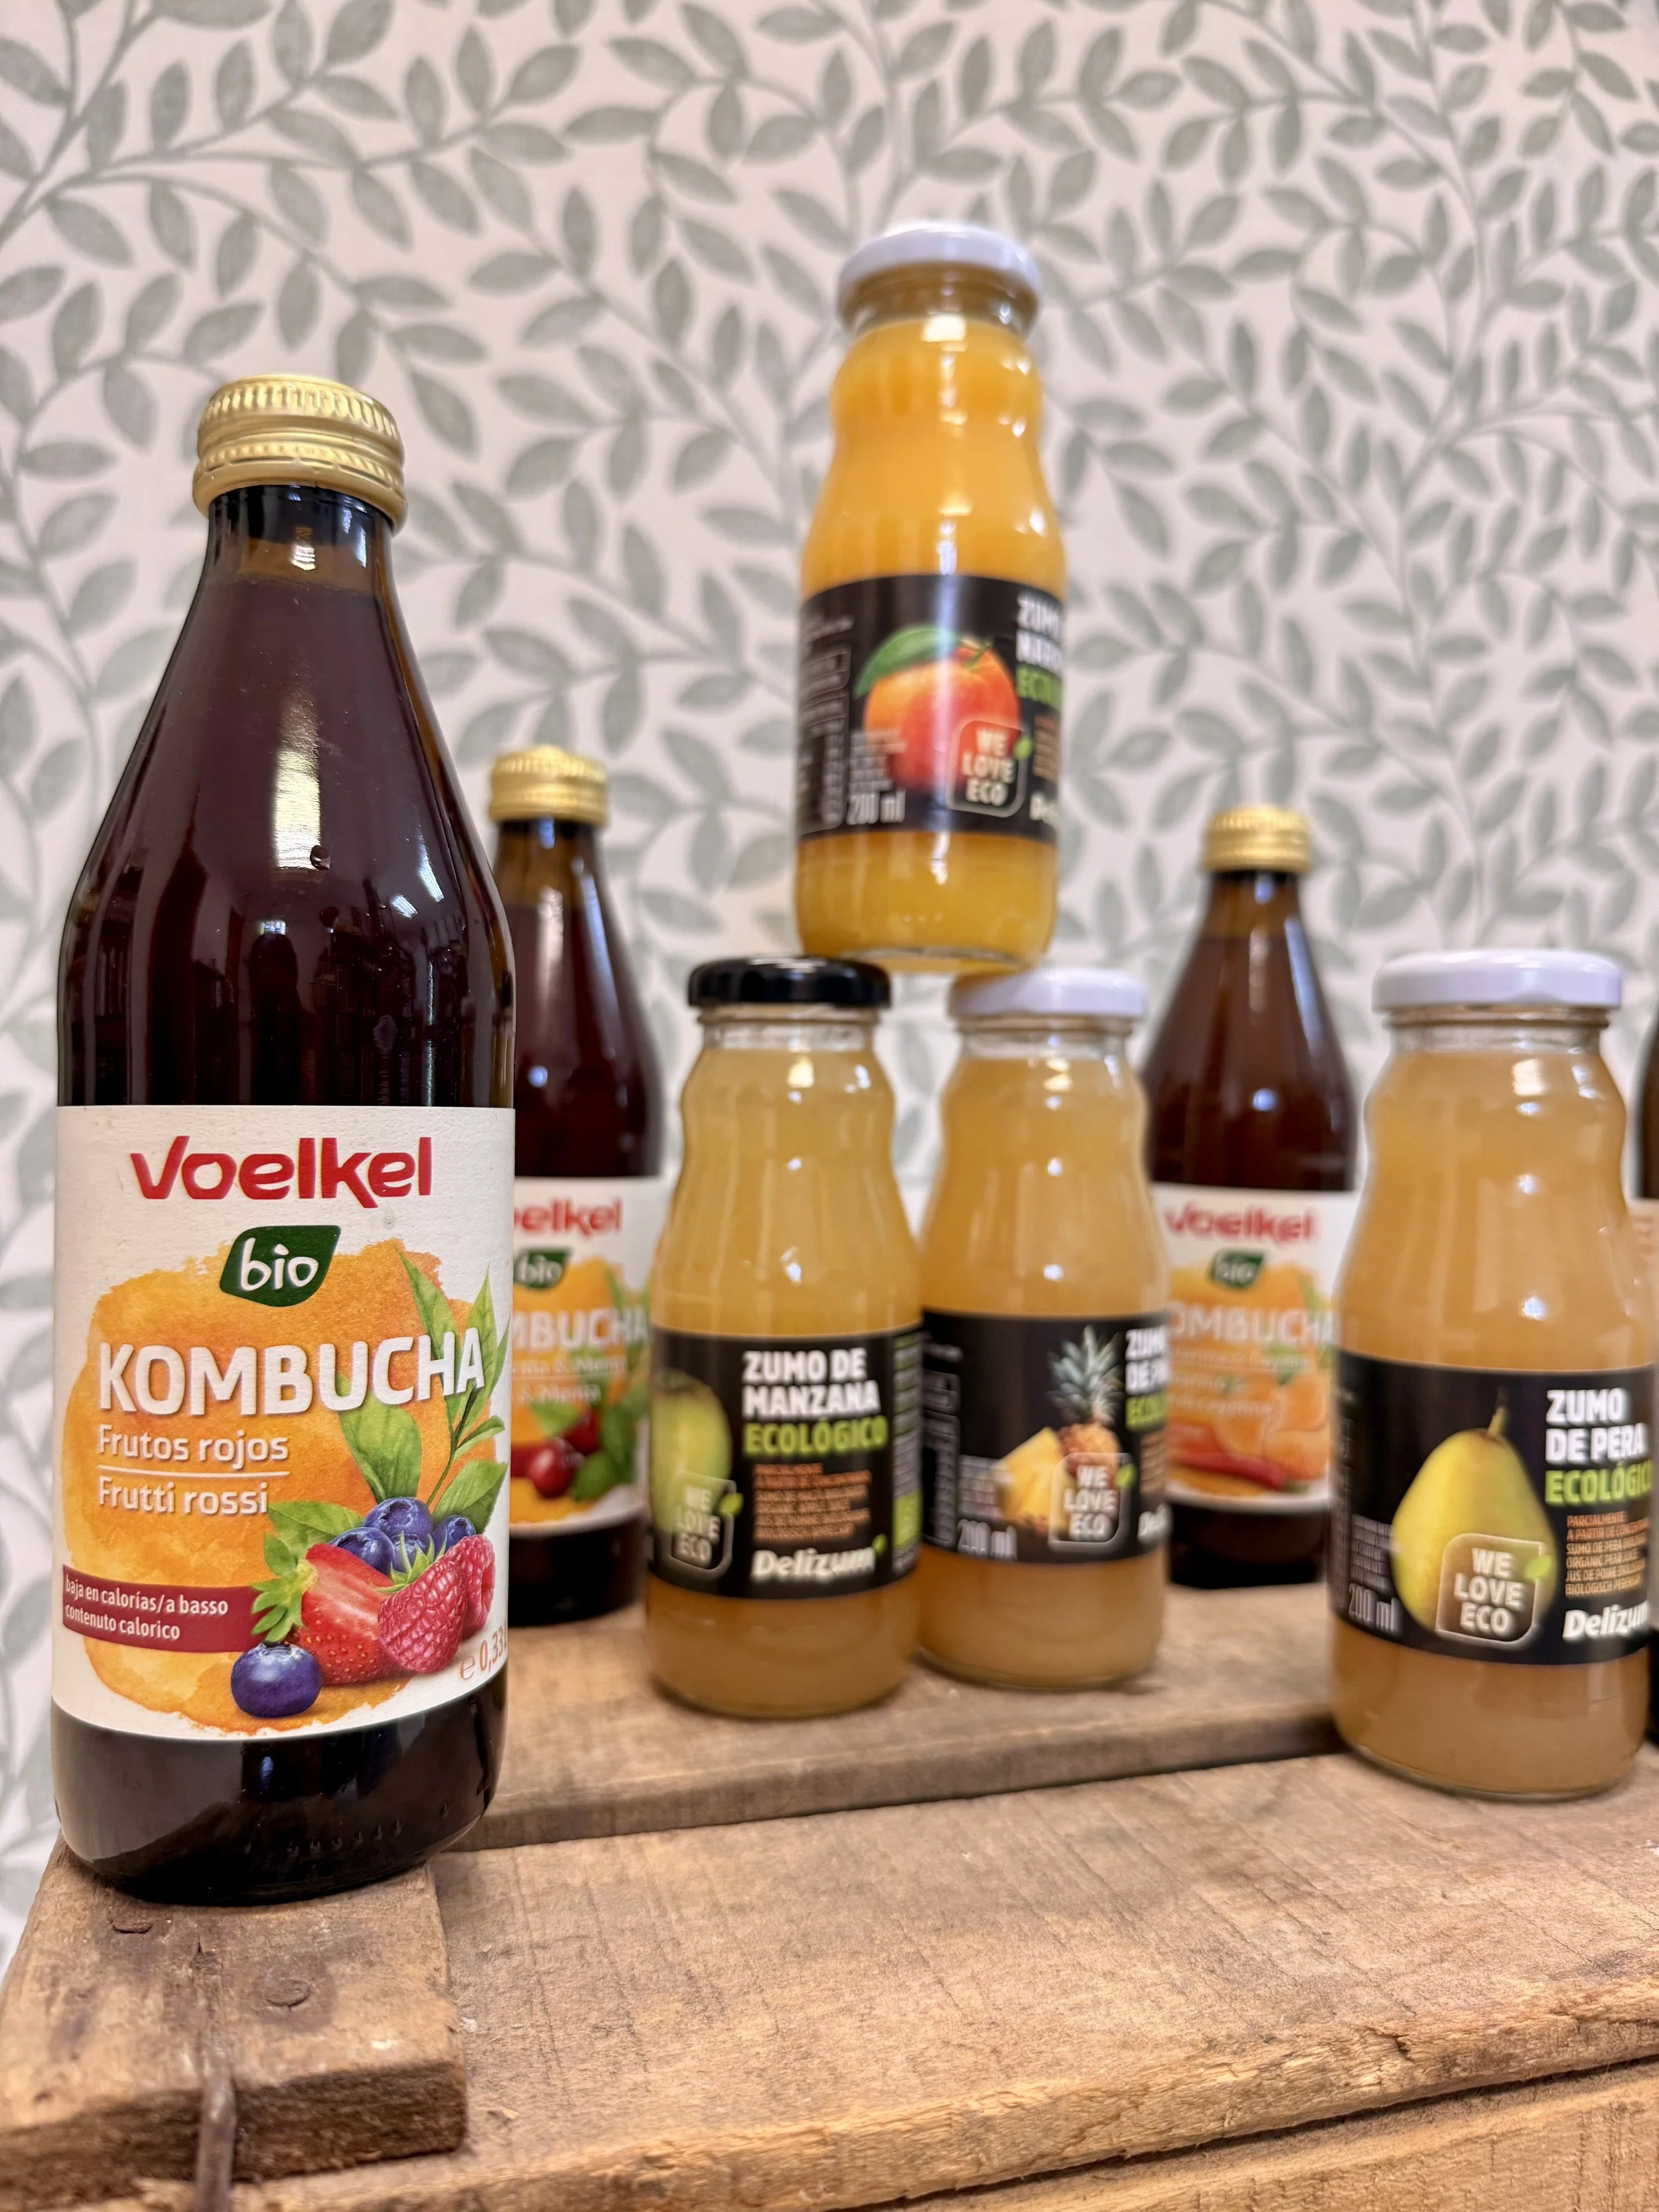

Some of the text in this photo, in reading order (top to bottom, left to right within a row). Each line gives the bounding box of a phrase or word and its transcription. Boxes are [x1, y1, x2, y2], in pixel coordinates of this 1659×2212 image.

[975, 728, 1007, 757] WE
[961, 751, 1015, 784] LOVE
[966, 777, 1009, 807] ECO
[129, 1135, 432, 1209] Voelkel
[514, 1198, 622, 1237] elkel
[239, 1237, 319, 1291] bio
[99, 1327, 485, 1416] KOMBUCHA
[742, 1347, 867, 1384] ZUMO DE
[742, 1380, 881, 1418] MANZANA
[1546, 1388, 1628, 1426] ZUMO
[97, 1424, 289, 1469] Frutos rojos
[743, 1414, 889, 1455] ECOLÓGICO
[1546, 1423, 1648, 1465] DE PERA
[97, 1475, 268, 1516] Frutti rossi
[1078, 1465, 1108, 1489] WE
[1064, 1489, 1118, 1518] LOVE
[1069, 1512, 1112, 1542] ECO
[1471, 1548, 1514, 1576] WE
[1566, 1542, 1591, 1555] SUMO
[1566, 1554, 1603, 1569] ORGANIC
[66, 1573, 84, 1601] baja
[86, 1586, 99, 1601] en
[179, 1594, 229, 1615] basso
[1454, 1573, 1526, 1607] LOVE
[66, 1603, 180, 1640] contenuto calorico
[1459, 1602, 1510, 1634] ECO
